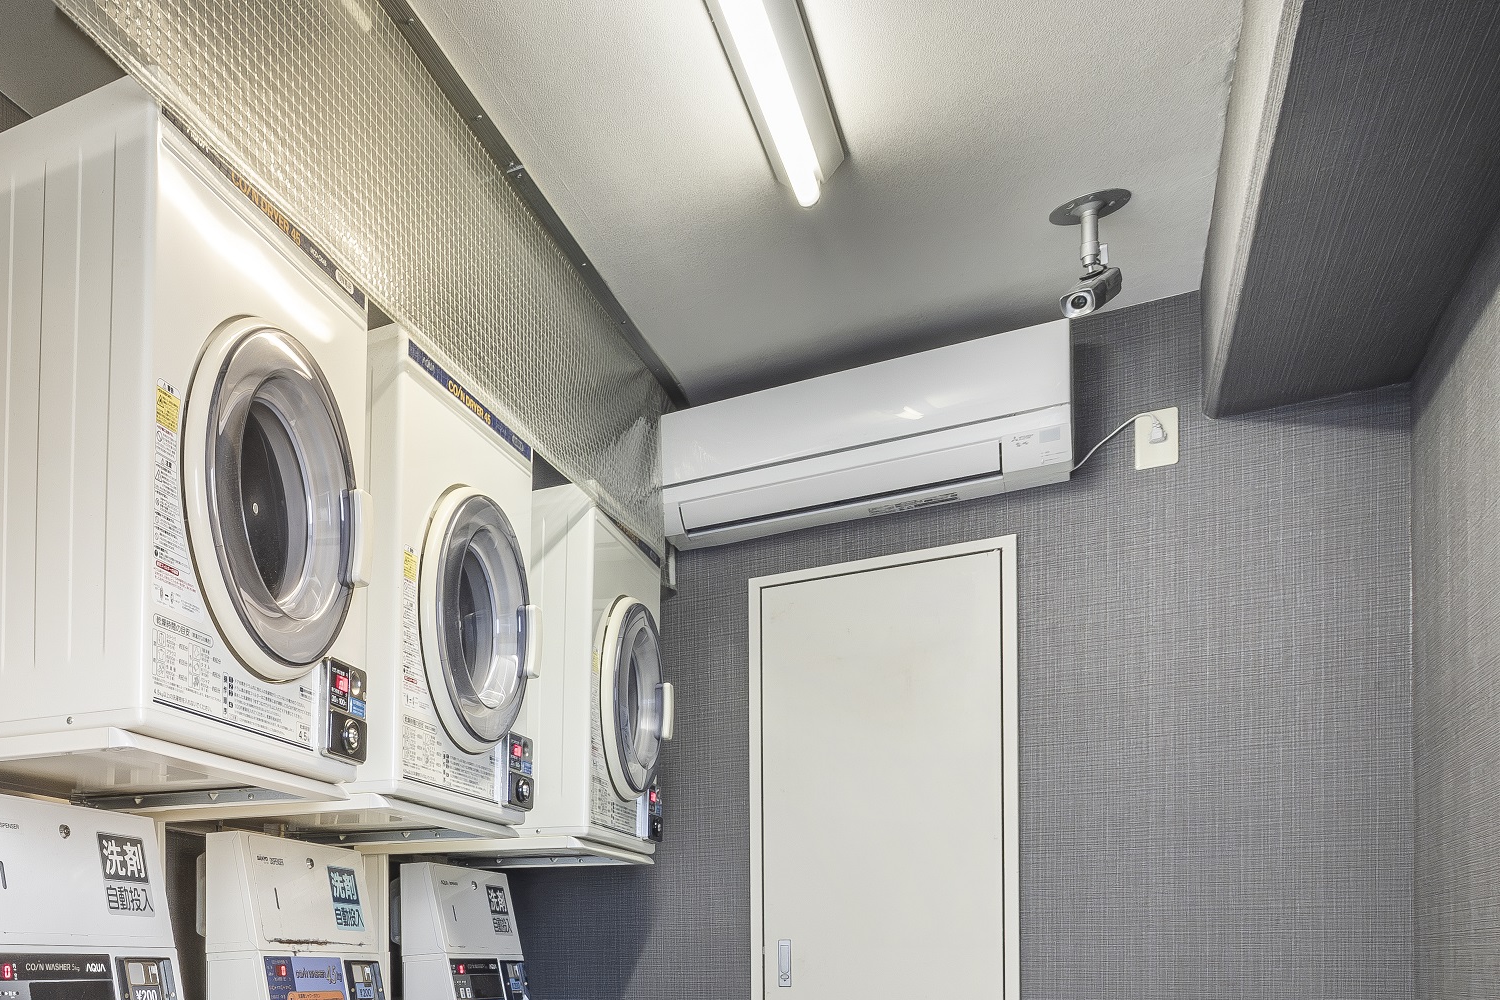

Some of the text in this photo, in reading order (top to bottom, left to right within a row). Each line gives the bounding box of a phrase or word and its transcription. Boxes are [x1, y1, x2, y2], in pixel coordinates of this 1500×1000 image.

[448, 380, 466, 403] COIN
[466, 394, 484, 419] DRYER
[102, 839, 146, 879] 洗剤
[106, 885, 154, 912] 自動投入
[331, 872, 357, 900] 洗剤
[334, 907, 365, 928] 自動投入
[45, 963, 71, 972] WASHER
[86, 963, 106, 973] AQUA
